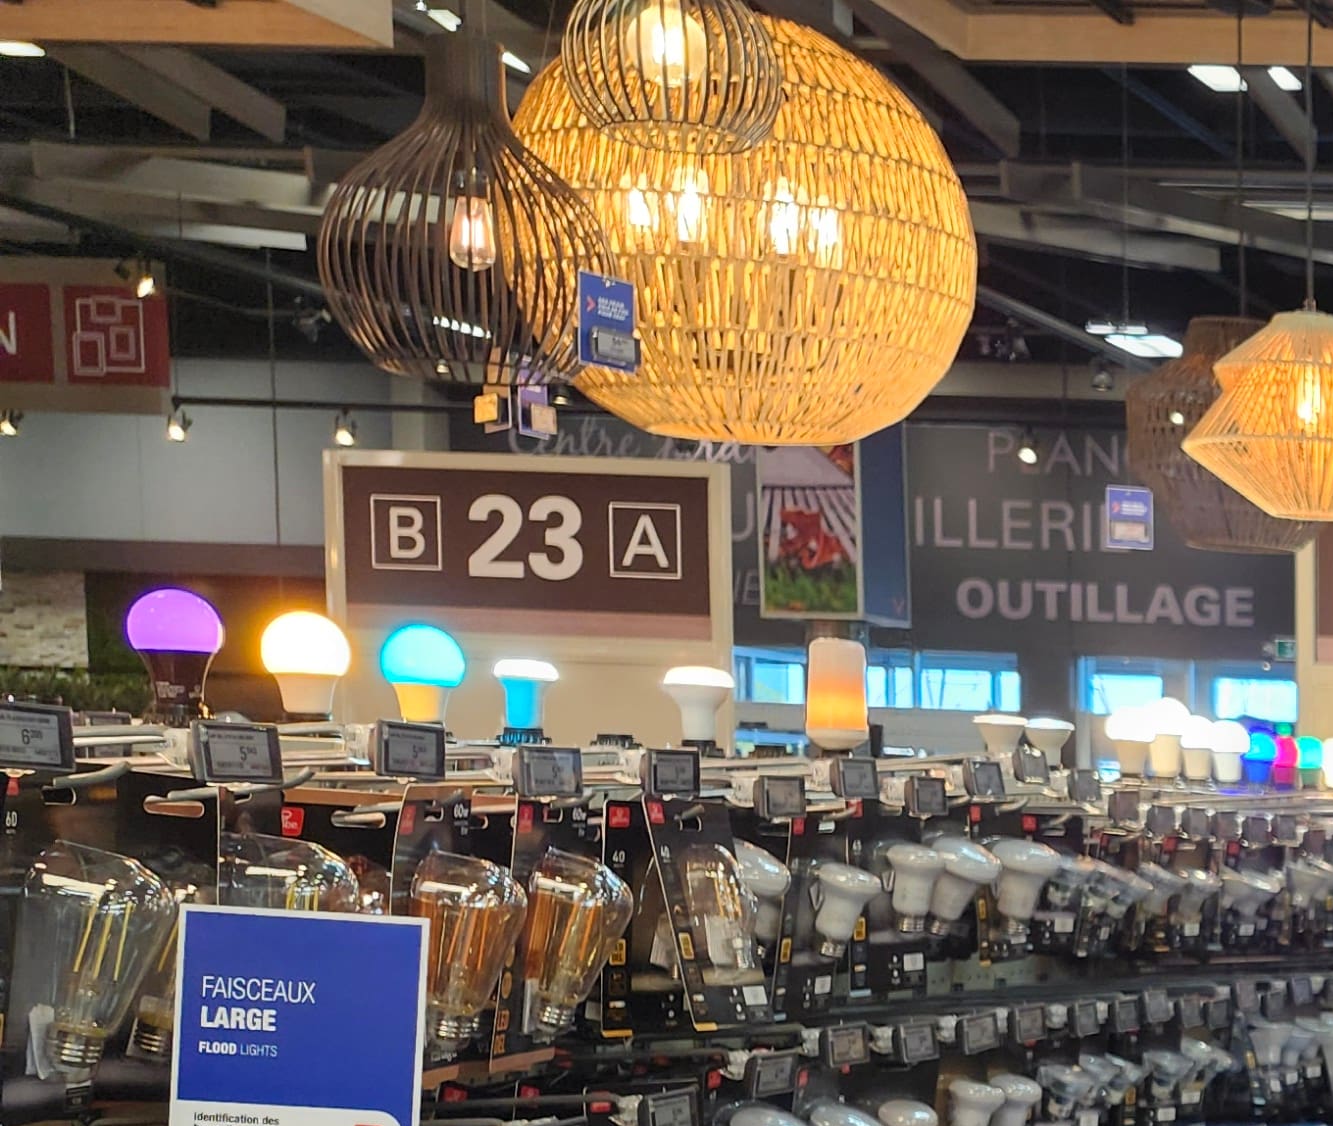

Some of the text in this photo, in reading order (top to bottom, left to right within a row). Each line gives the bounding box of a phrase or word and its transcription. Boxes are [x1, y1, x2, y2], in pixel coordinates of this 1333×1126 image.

[388, 506, 428, 561] B
[467, 493, 585, 582] 23
[621, 513, 670, 569] A
[915, 496, 1130, 554] ILLERI
[956, 577, 1256, 629] OUTILLAGE
[201, 975, 316, 1005] FAISCEAUX
[200, 1005, 278, 1032] LARGE
[198, 1040, 278, 1058] FLOOD LIGHTS
[193, 1112, 280, 1126] Identification des
